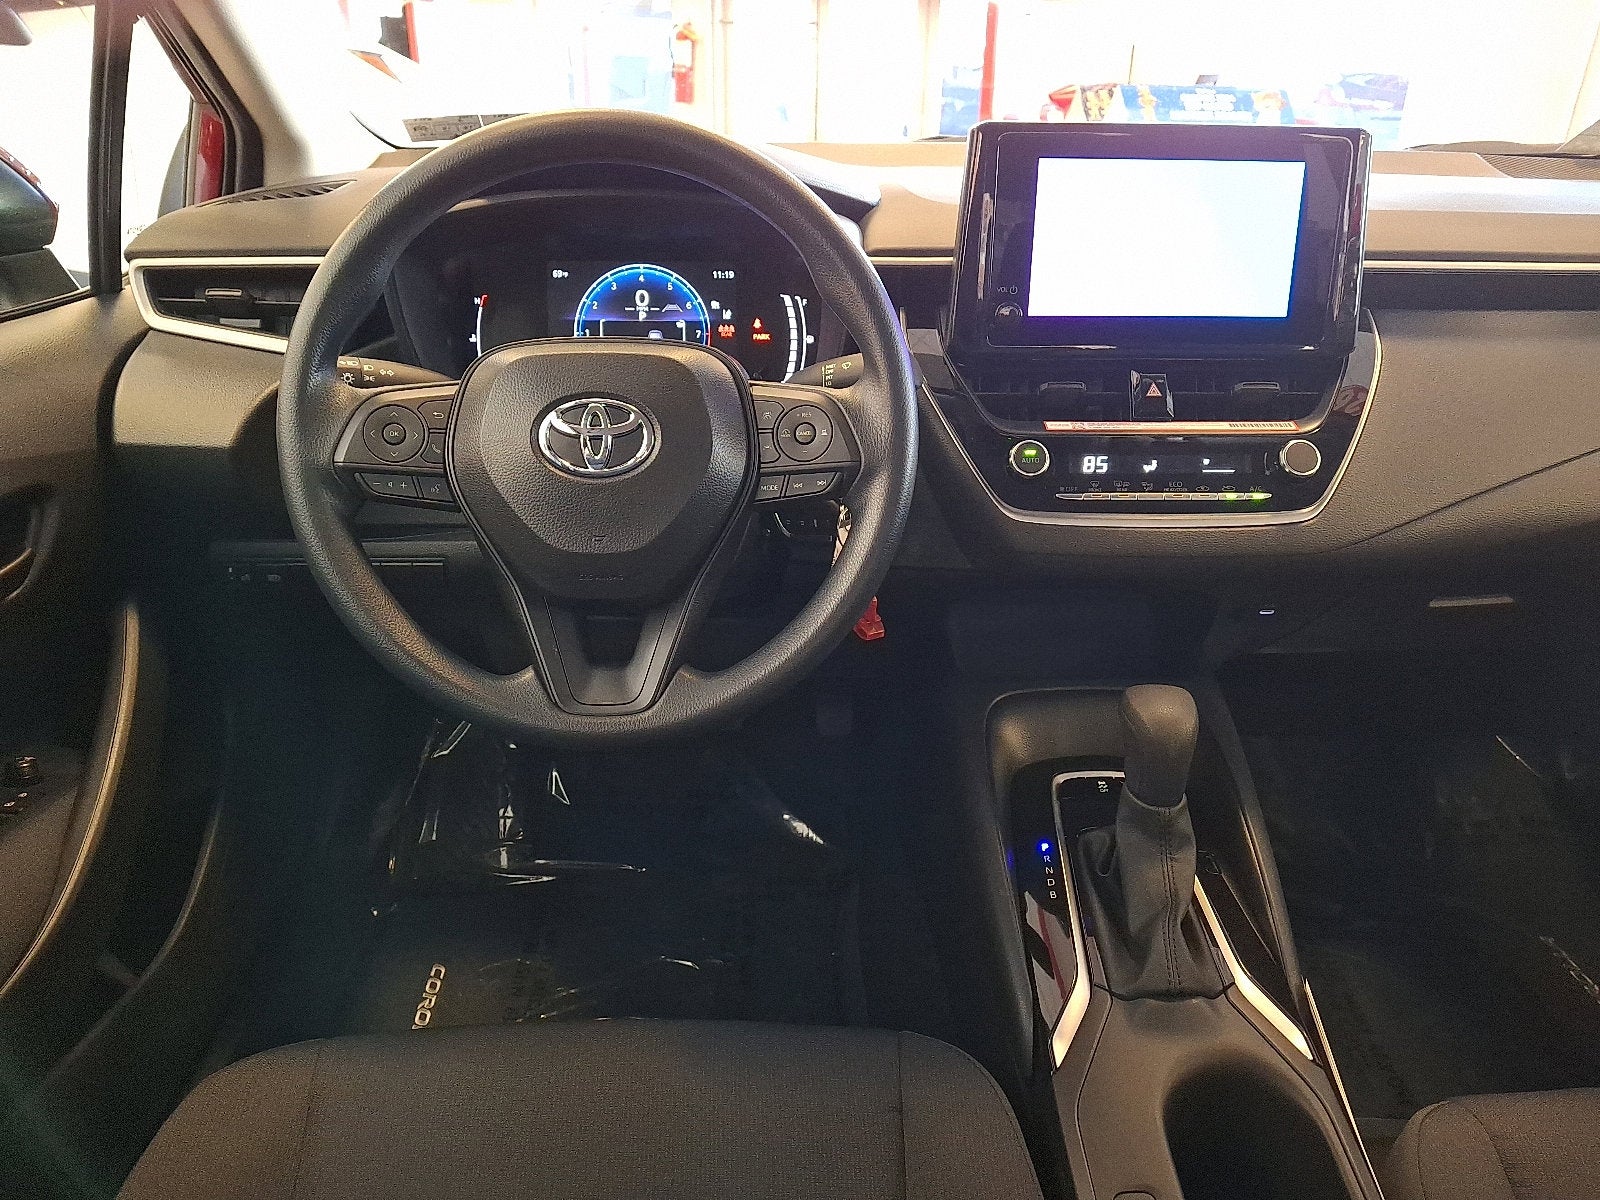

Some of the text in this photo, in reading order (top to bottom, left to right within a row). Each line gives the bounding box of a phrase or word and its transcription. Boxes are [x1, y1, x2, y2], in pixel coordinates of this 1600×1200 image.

[638, 274, 645, 282] 4
[712, 270, 735, 279] 11:19
[610, 282, 617, 290] 3
[667, 282, 673, 291] 5
[635, 289, 649, 307] 0
[592, 301, 598, 310] 2
[685, 301, 692, 310] 6
[638, 311, 647, 321] P
[695, 330, 701, 339] 7
[1082, 455, 1109, 474] 85
[760, 484, 779, 492] MODE
[1044, 855, 1051, 863] R
[1045, 866, 1054, 874] N
[1047, 878, 1055, 887] D
[1050, 890, 1057, 899] B
[411, 963, 446, 1030] CORO
